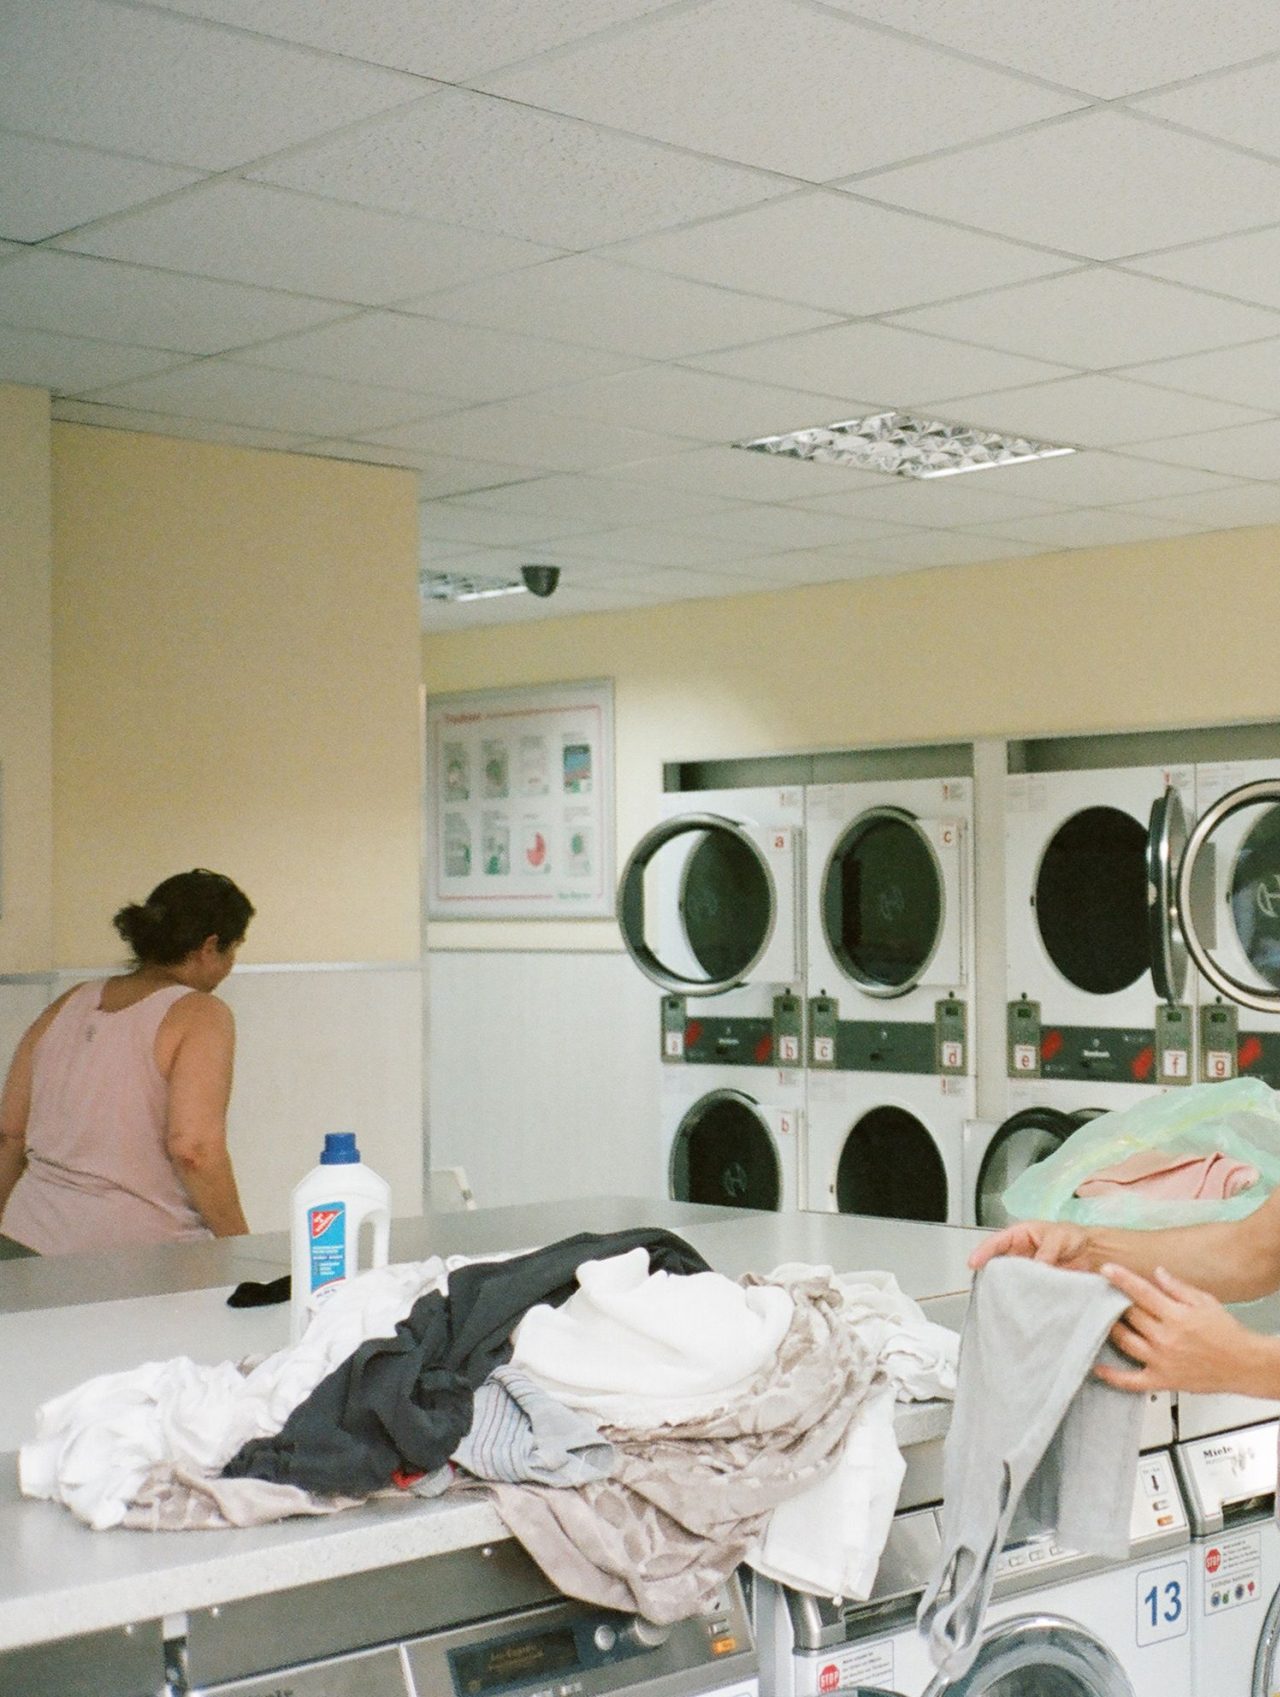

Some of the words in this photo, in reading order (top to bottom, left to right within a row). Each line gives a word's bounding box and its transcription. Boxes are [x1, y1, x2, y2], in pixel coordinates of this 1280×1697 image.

[774, 835, 785, 849] a
[943, 830, 952, 844] c
[783, 1043, 794, 1060] b
[820, 1046, 830, 1059] c
[948, 1051, 959, 1066] d
[1021, 1055, 1031, 1069] e
[1171, 1057, 1180, 1074] f
[1214, 1061, 1226, 1079] g
[780, 1117, 790, 1133] b
[1203, 1446, 1232, 1459] Miele
[1145, 1580, 1182, 1627] 13
